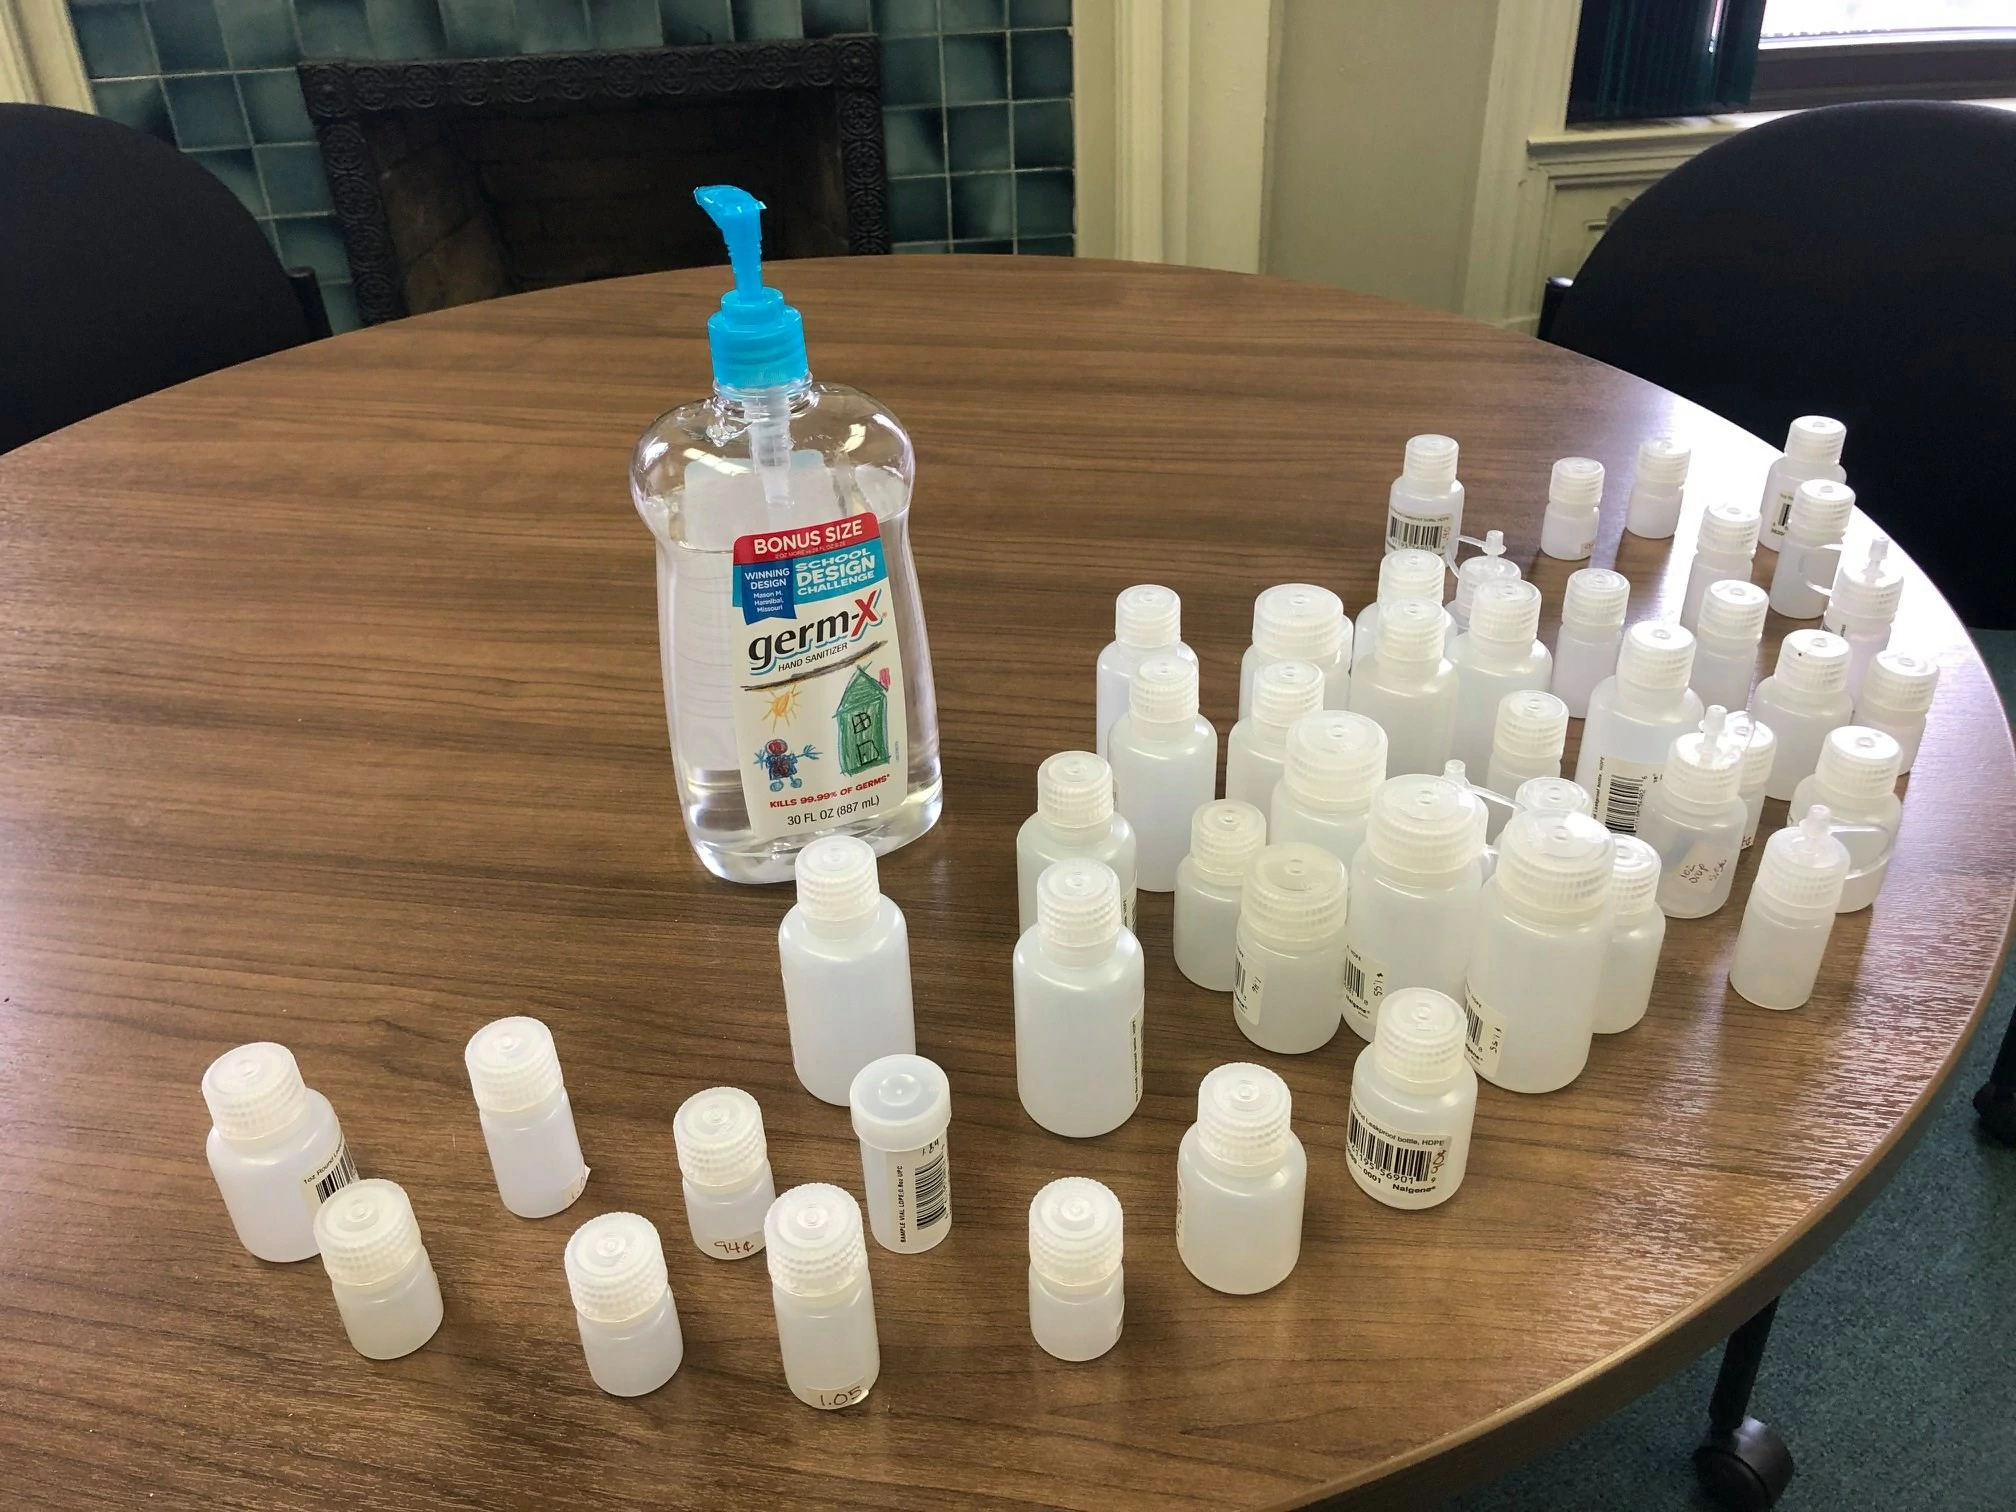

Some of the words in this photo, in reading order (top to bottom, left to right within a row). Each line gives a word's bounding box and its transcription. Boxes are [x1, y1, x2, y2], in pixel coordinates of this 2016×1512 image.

[754, 530, 821, 555] BONUS
[825, 519, 863, 543] SIZE
[795, 548, 871, 572] SCHOOL
[744, 567, 790, 581] WINNING
[796, 555, 875, 587] DESIGN
[750, 578, 787, 590] DESIGN
[797, 570, 875, 596] CHALLENGE
[757, 604, 783, 613] Missouri
[778, 658, 803, 673] HAND
[805, 642, 848, 664] SANITIZER
[769, 798, 798, 809] KILLS
[800, 791, 838, 805] 99.99%
[840, 786, 853, 796] OF
[787, 814, 801, 826] 30
[804, 812, 817, 823] FL
[820, 808, 834, 820] OZ
[837, 802, 858, 817] (887
[861, 795, 880, 809] mL)
[1366, 1117, 1396, 1140] Leakproof
[1397, 1136, 1420, 1146] bottle,
[1421, 1139, 1445, 1147] HDPE
[304, 1174, 316, 1185] 1oz
[896, 1165, 904, 1178] UPC
[1363, 1168, 1382, 1184] 0001
[1380, 1169, 1415, 1184] 56901
[898, 1209, 906, 1221] VIAL
[899, 1222, 907, 1243] SAMPLE
[820, 1385, 863, 1407] 1.05
